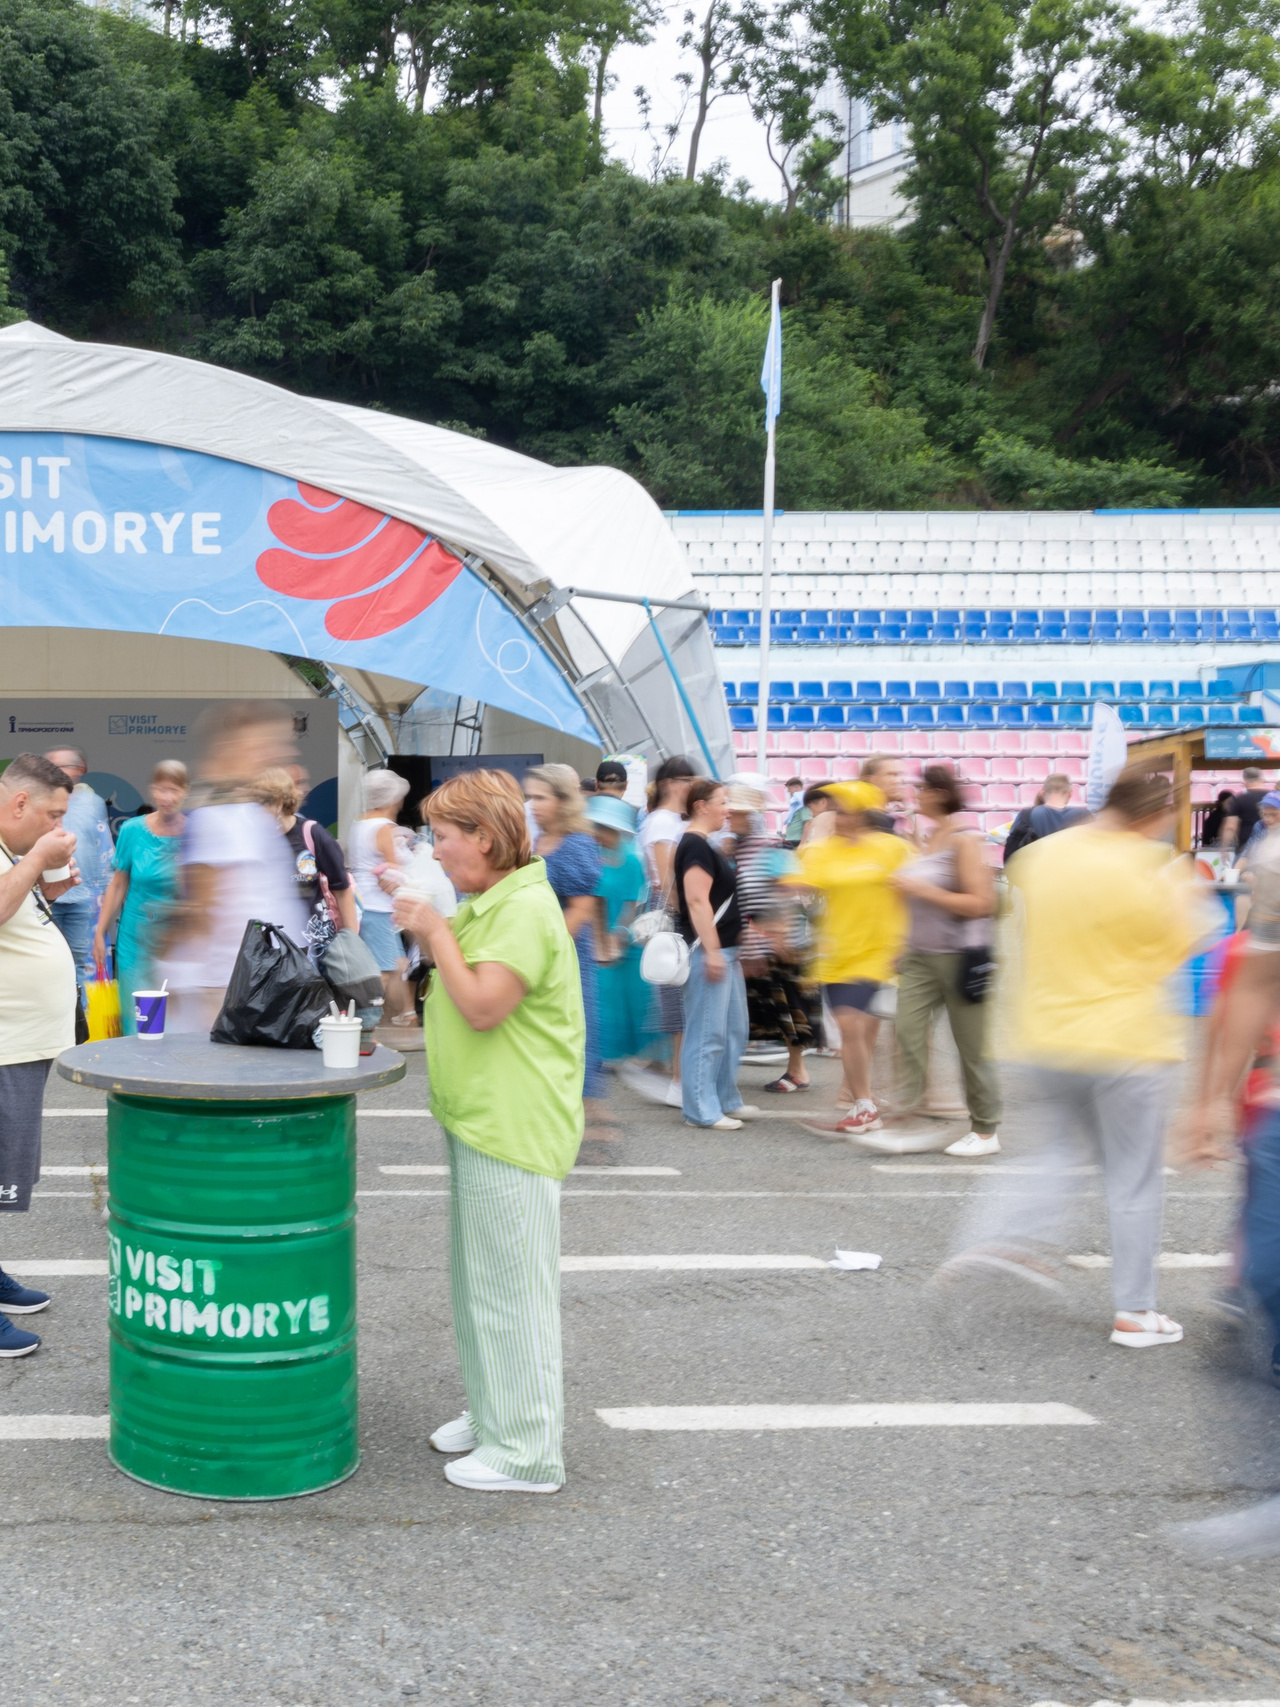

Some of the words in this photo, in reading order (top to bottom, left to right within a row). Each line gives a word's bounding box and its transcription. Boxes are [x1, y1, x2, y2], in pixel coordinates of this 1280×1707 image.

[129, 715, 158, 724] VISIT
[129, 725, 187, 735] PRIMORYE
[126, 1245, 223, 1296] VISIT
[125, 1285, 330, 1338] PRIMORYE
